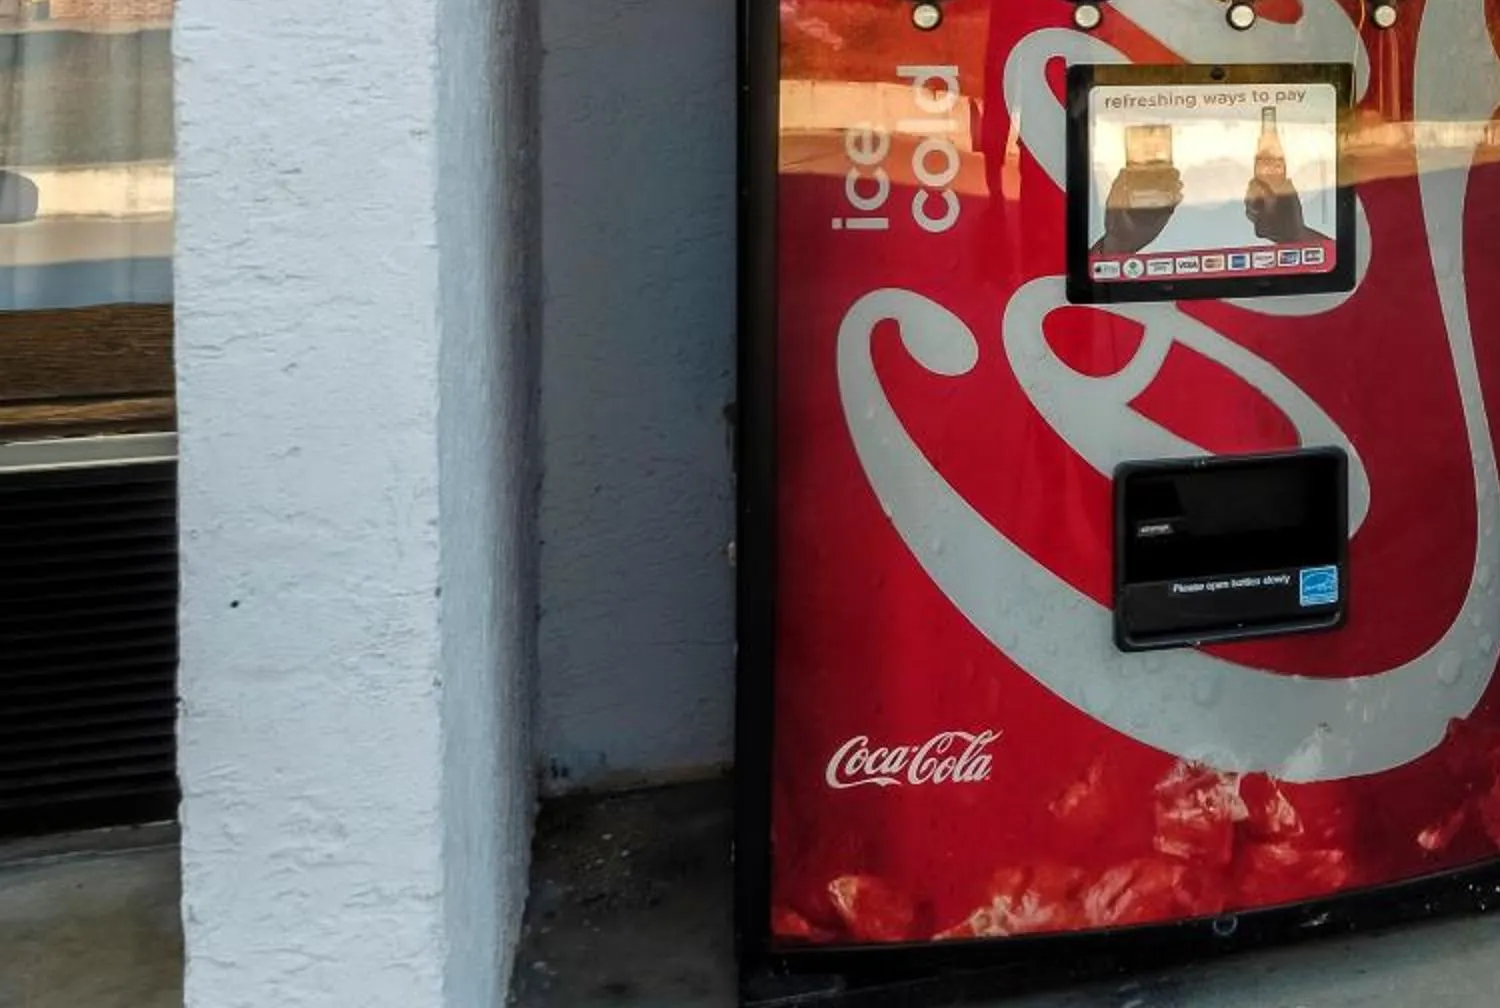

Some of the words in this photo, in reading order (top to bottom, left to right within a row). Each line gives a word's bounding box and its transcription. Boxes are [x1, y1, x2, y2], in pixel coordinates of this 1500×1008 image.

[1104, 91, 1197, 108] refreshing
[1203, 92, 1247, 107] ways
[1252, 89, 1270, 103] to
[1276, 88, 1306, 104] pay
[832, 121, 891, 229] ice
[896, 65, 961, 232] cold
[825, 729, 1004, 789] Coca-Cola
